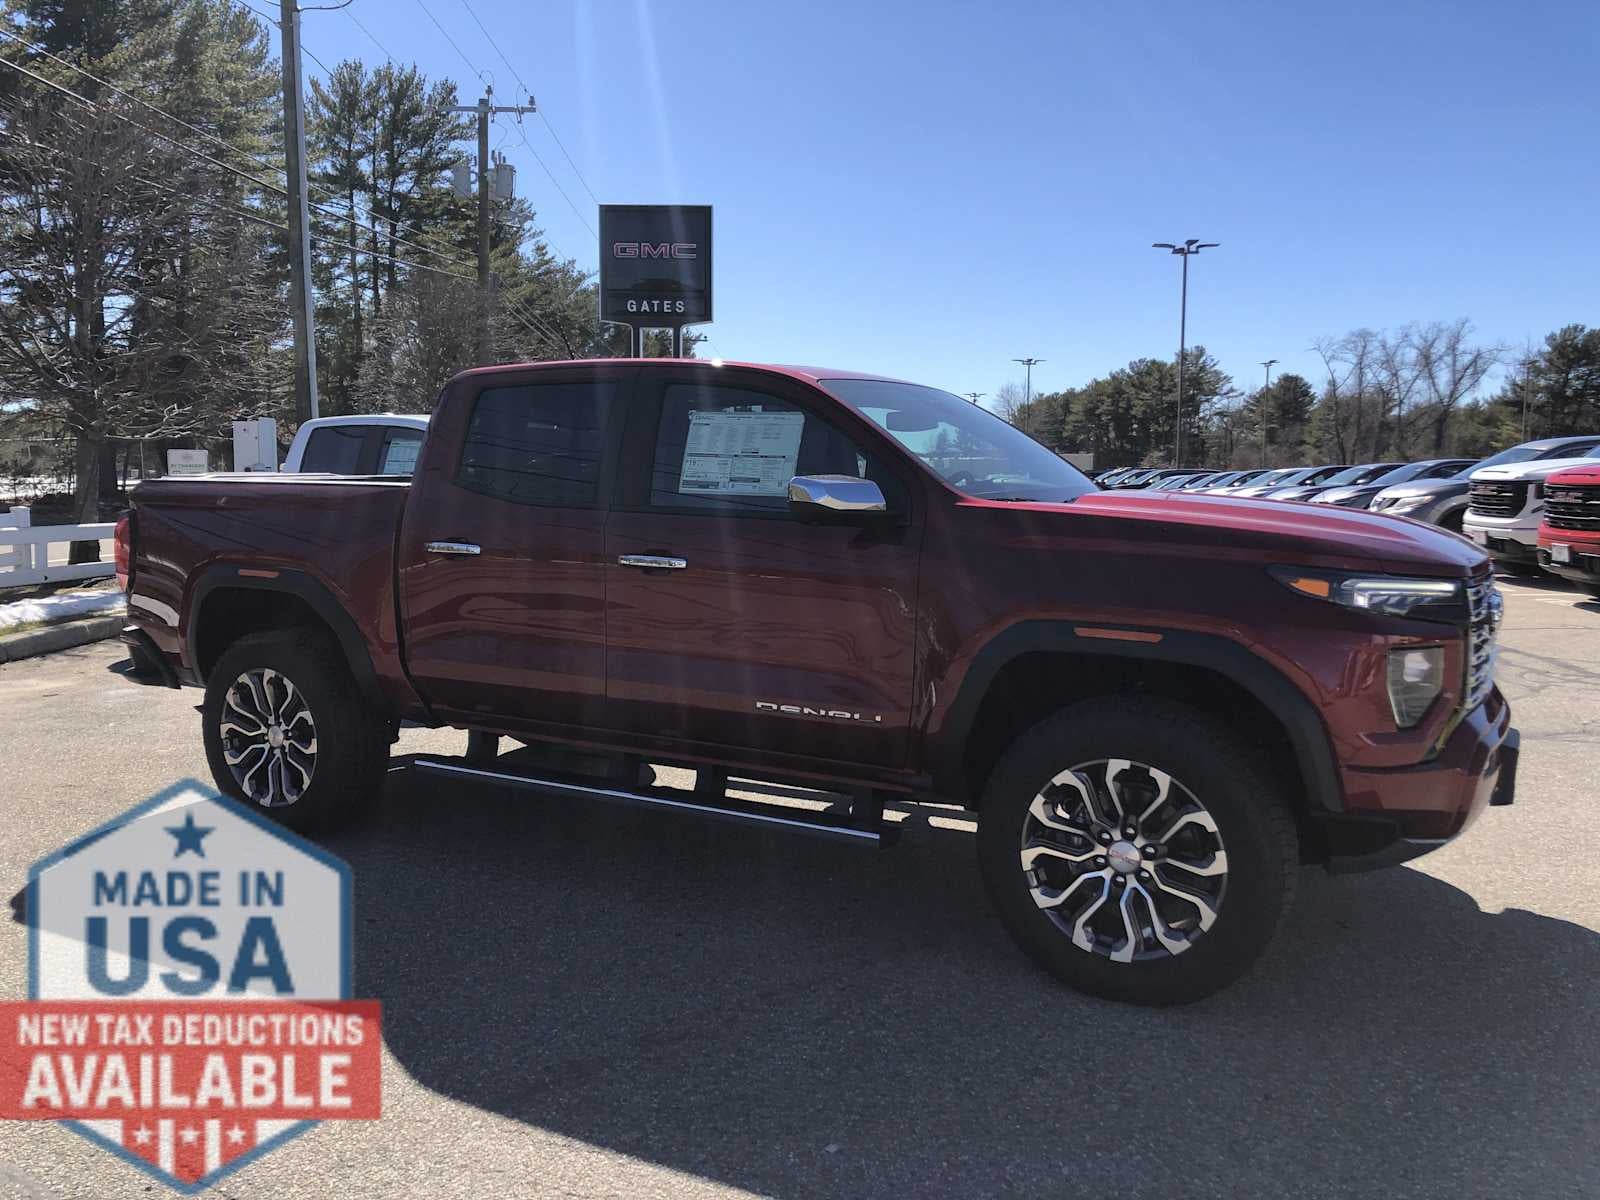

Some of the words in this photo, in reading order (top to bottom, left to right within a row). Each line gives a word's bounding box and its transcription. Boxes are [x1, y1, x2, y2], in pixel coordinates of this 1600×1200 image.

[613, 242, 697, 259] GMC
[626, 299, 686, 313] GATES
[755, 701, 882, 723] DENALI
